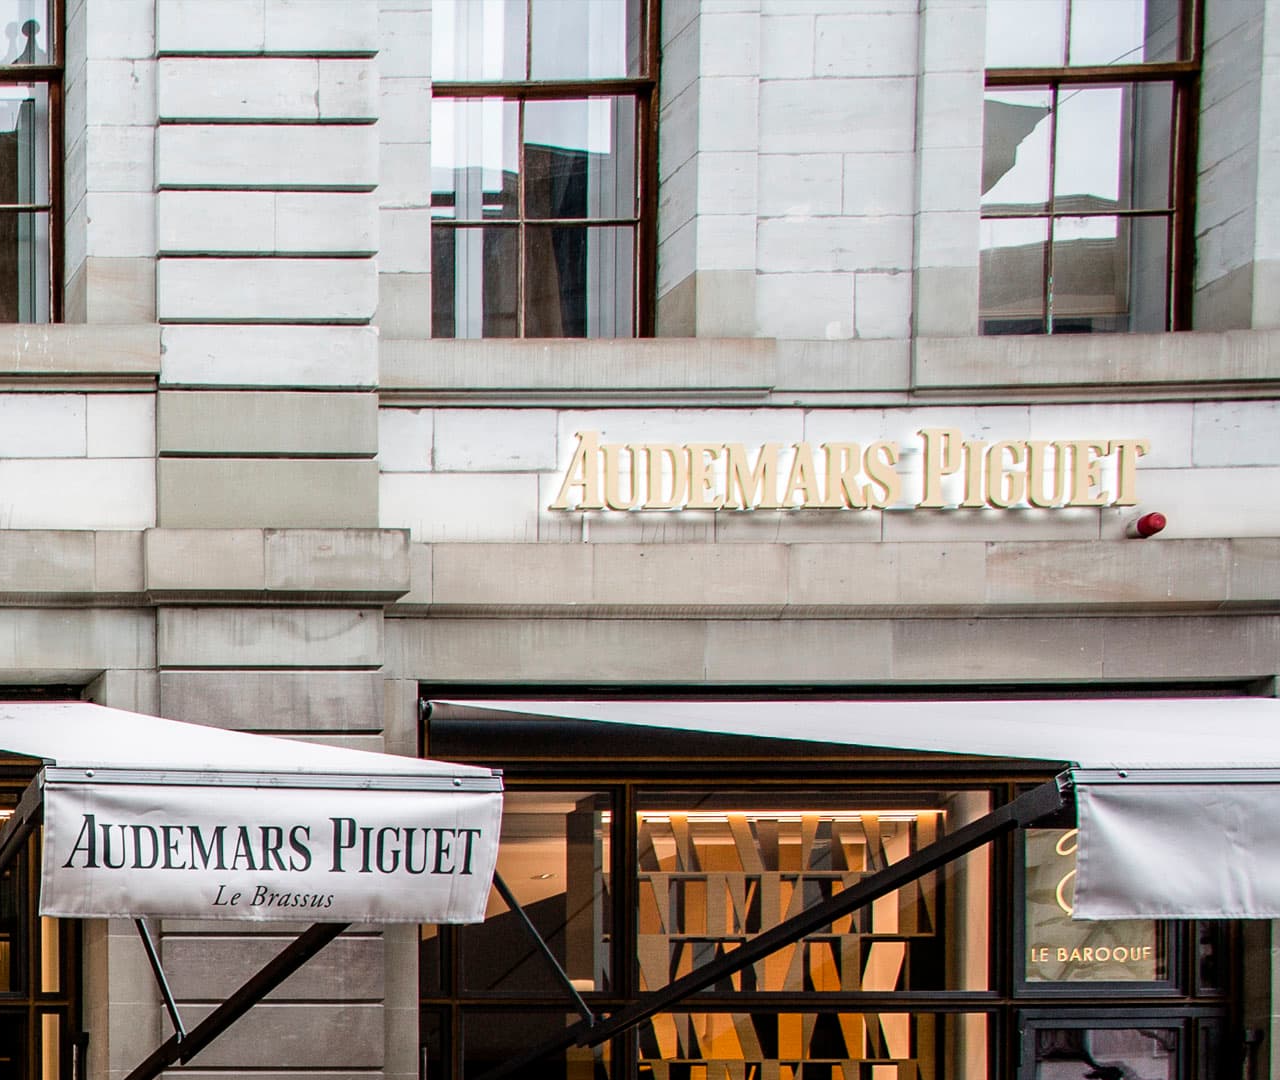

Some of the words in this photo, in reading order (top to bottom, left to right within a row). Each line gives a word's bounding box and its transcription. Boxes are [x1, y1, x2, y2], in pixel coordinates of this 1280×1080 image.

[548, 431, 901, 512] AUDEMARS
[915, 427, 1150, 511] PIGUET
[61, 814, 312, 873] AUDEMARS
[328, 817, 482, 875] PIGUET
[212, 885, 242, 907] Le
[250, 885, 334, 909] Brassus
[1031, 947, 1049, 962] LE
